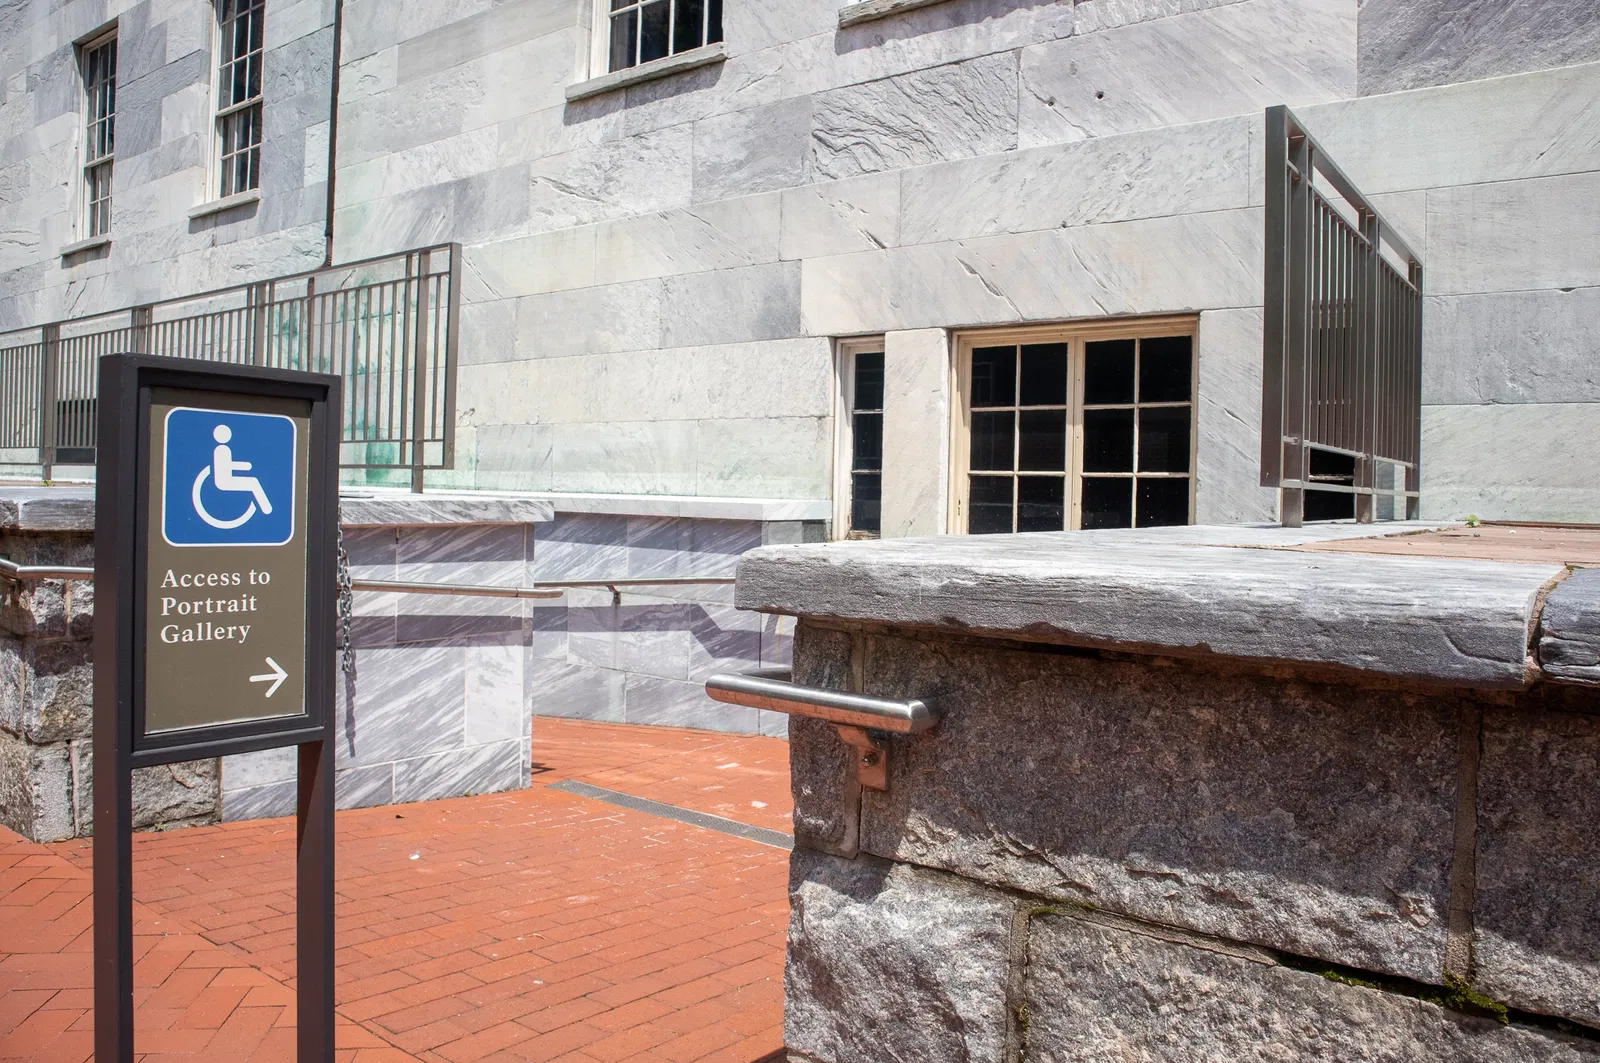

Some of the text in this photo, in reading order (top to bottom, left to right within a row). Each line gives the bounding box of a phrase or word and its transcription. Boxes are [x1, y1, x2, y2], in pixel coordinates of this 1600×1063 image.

[160, 568, 271, 588] Access to
[160, 593, 258, 616] Portrait
[160, 621, 251, 644] Gallery
